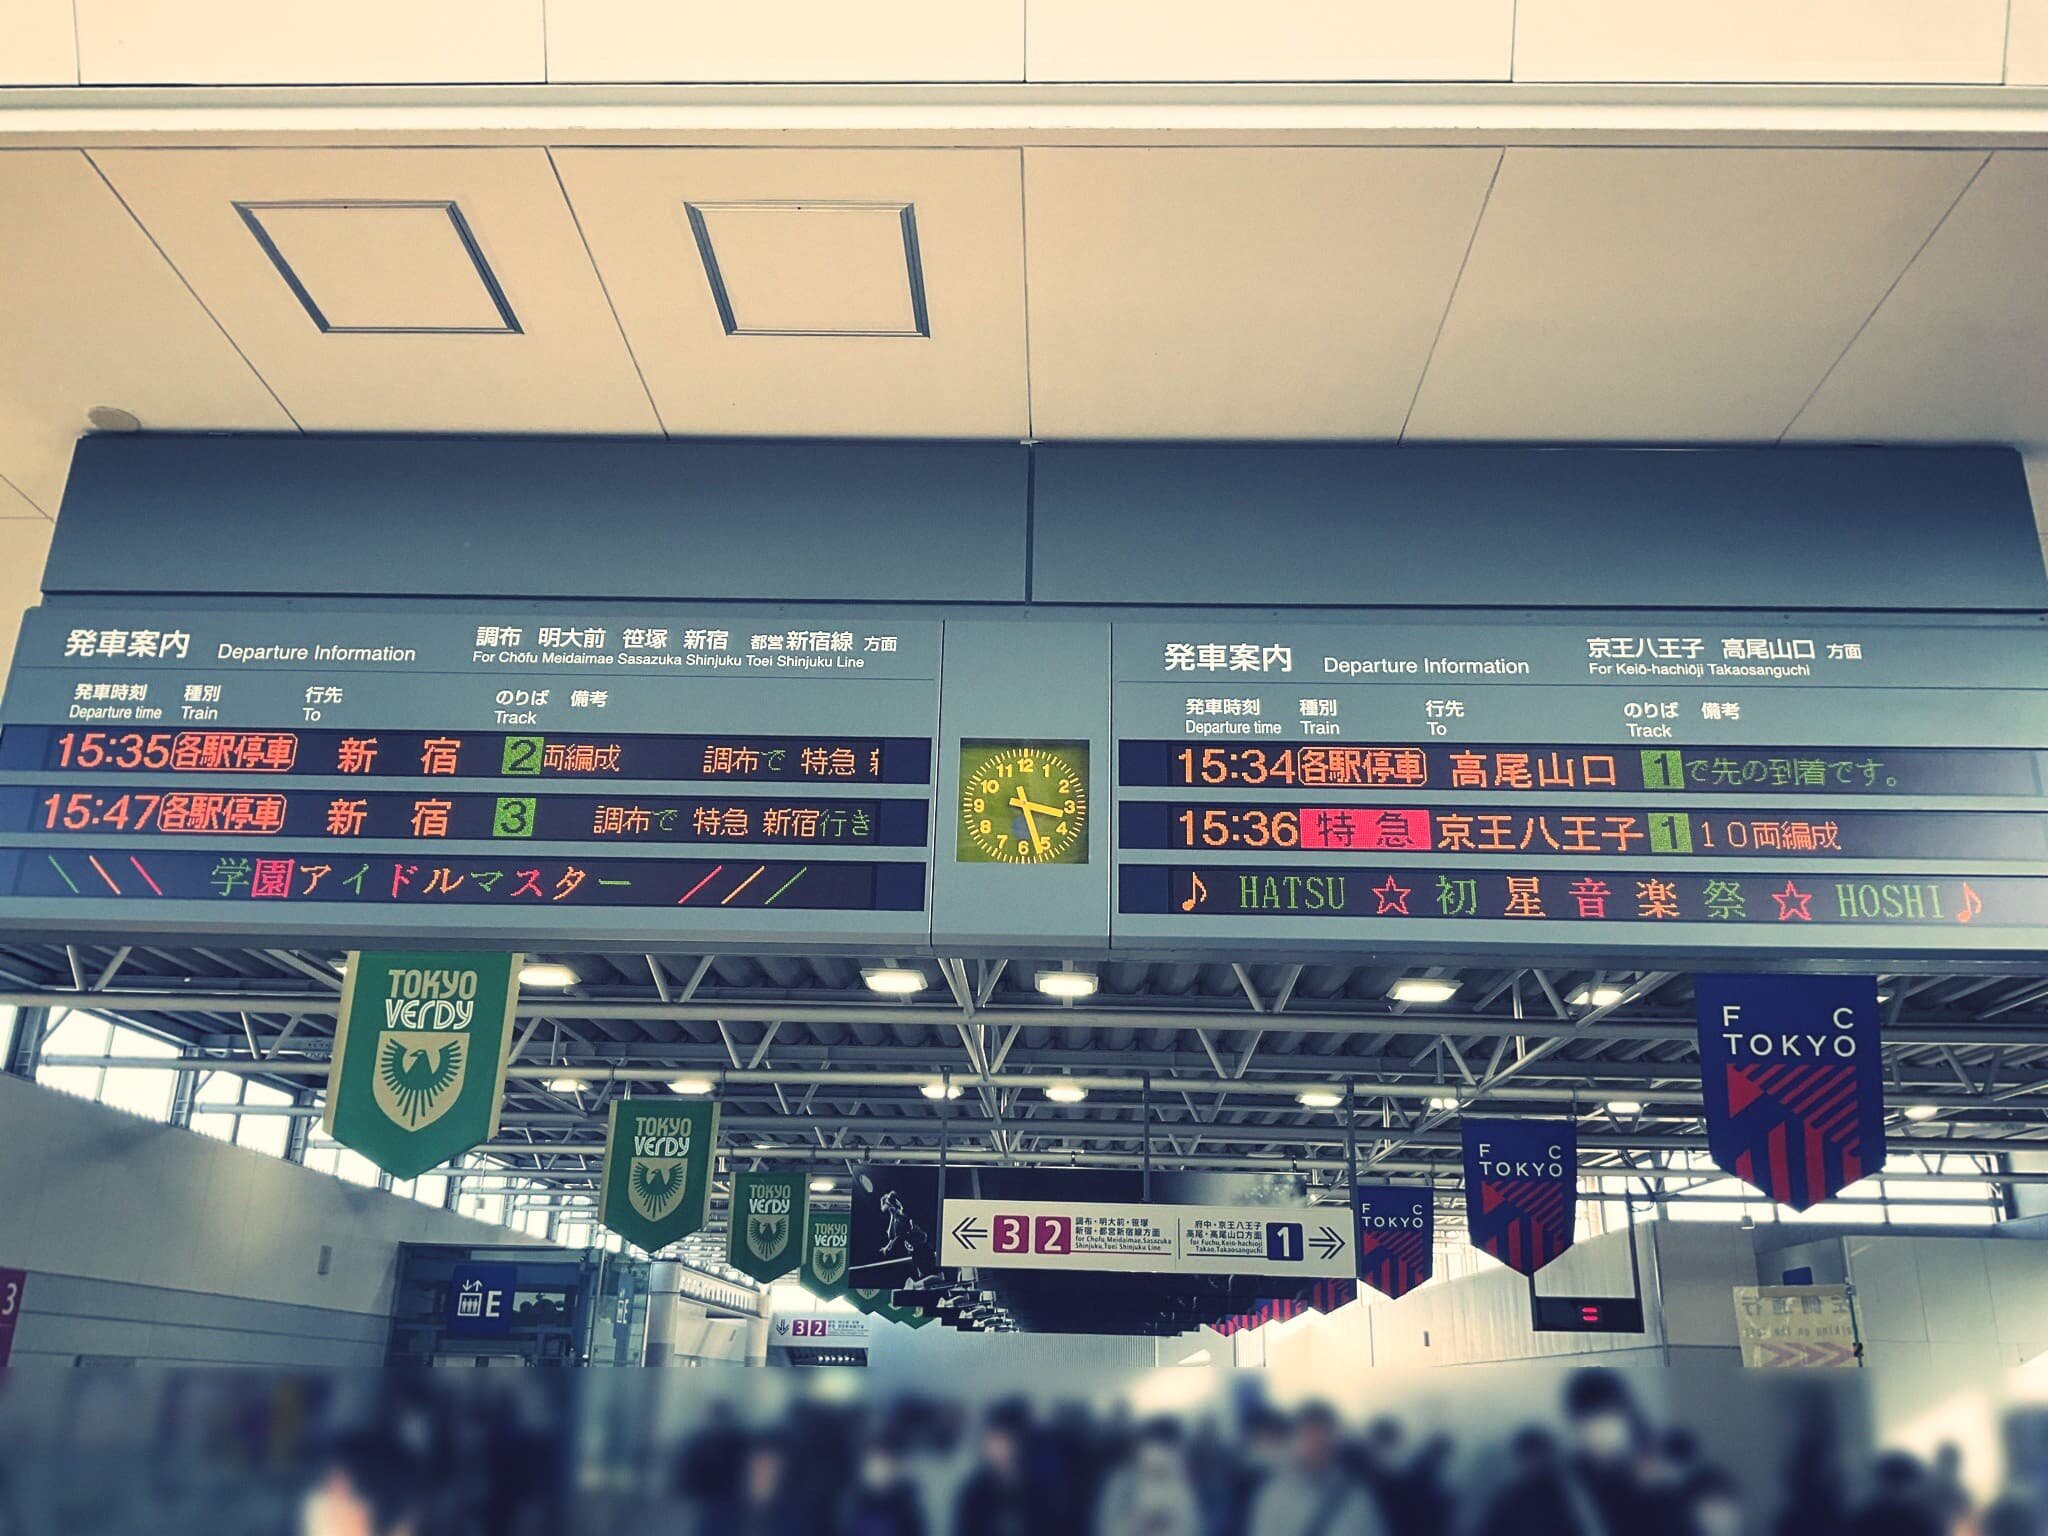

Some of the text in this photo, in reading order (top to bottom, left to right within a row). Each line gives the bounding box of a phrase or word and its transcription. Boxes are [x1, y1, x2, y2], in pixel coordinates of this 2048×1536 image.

[64, 629, 191, 659] 発車案内
[475, 626, 522, 648] 調布
[538, 627, 607, 650] 明大前
[622, 628, 668, 650] 笹塚
[683, 629, 729, 651] 新宿
[863, 636, 898, 652] 方面
[1587, 637, 1863, 660] 京王八王子 高尾山口 方面
[217, 643, 416, 663] Departure Information
[472, 651, 865, 670] For Chōfu Meidaimae Sasazuka Shinjuku Toei Shinjuku Line
[1164, 643, 1292, 672] 発車案内
[1324, 657, 1529, 676] Departure Information
[1589, 663, 1811, 678] For Keiō-hachiōji Takaosanguchi
[74, 683, 609, 708] 発車時刻 種別 行先 のりば 備考
[69, 704, 537, 725] Departure time Train To Track
[1186, 698, 1741, 720] 発車時刻 種別 行先 のりば 備考
[1185, 720, 1672, 738] Departure time Train To Track
[58, 733, 171, 768] 15:35
[174, 735, 293, 767] 各駅停車
[509, 740, 537, 773] 2
[544, 744, 622, 772] 両編成
[703, 746, 786, 774] 調布で
[801, 747, 857, 776] 特急
[997, 763, 1013, 778] 11
[1018, 758, 1034, 773] 12
[1042, 763, 1050, 778] 1
[1179, 748, 1899, 788] 15:34 各駅停車 高尾山口 1 で先の到着です。
[980, 779, 1000, 794] 10
[1059, 779, 1070, 794] 2
[973, 798, 985, 813] 9
[1064, 799, 1076, 814] 3
[45, 793, 160, 830] 15:47
[161, 795, 281, 828] 各駅停車
[500, 801, 526, 834] 3
[593, 805, 678, 834] 調布で
[693, 807, 749, 836] 特急
[762, 808, 871, 838] 新宿行き
[979, 819, 992, 834] 8
[1055, 821, 1068, 835] 4
[1179, 809, 1298, 847] 15:36
[1436, 813, 1645, 852] 京王八王子
[1661, 815, 1678, 850] 1
[996, 834, 1009, 849] 7
[1018, 840, 1029, 855] 6
[1040, 836, 1051, 850] 5
[1239, 875, 1345, 909] HATSU
[1837, 882, 1945, 919] HOSHI
[388, 969, 478, 999] TOKYO
[1723, 1034, 1857, 1057] TOKYO
[635, 1117, 692, 1136] TOKYO
[1479, 1161, 1563, 1177] TOKYO
[749, 1184, 791, 1199] TOKYO
[814, 1223, 848, 1235] TOKYO
[1361, 1216, 1423, 1228] TOKYO
[1002, 1219, 1062, 1251] 3 2
[1277, 1227, 1290, 1257] 1
[2, 1283, 17, 1315] 3
[485, 1290, 502, 1317] E
[796, 1321, 804, 1335] 3
[814, 1321, 822, 1335] 2
